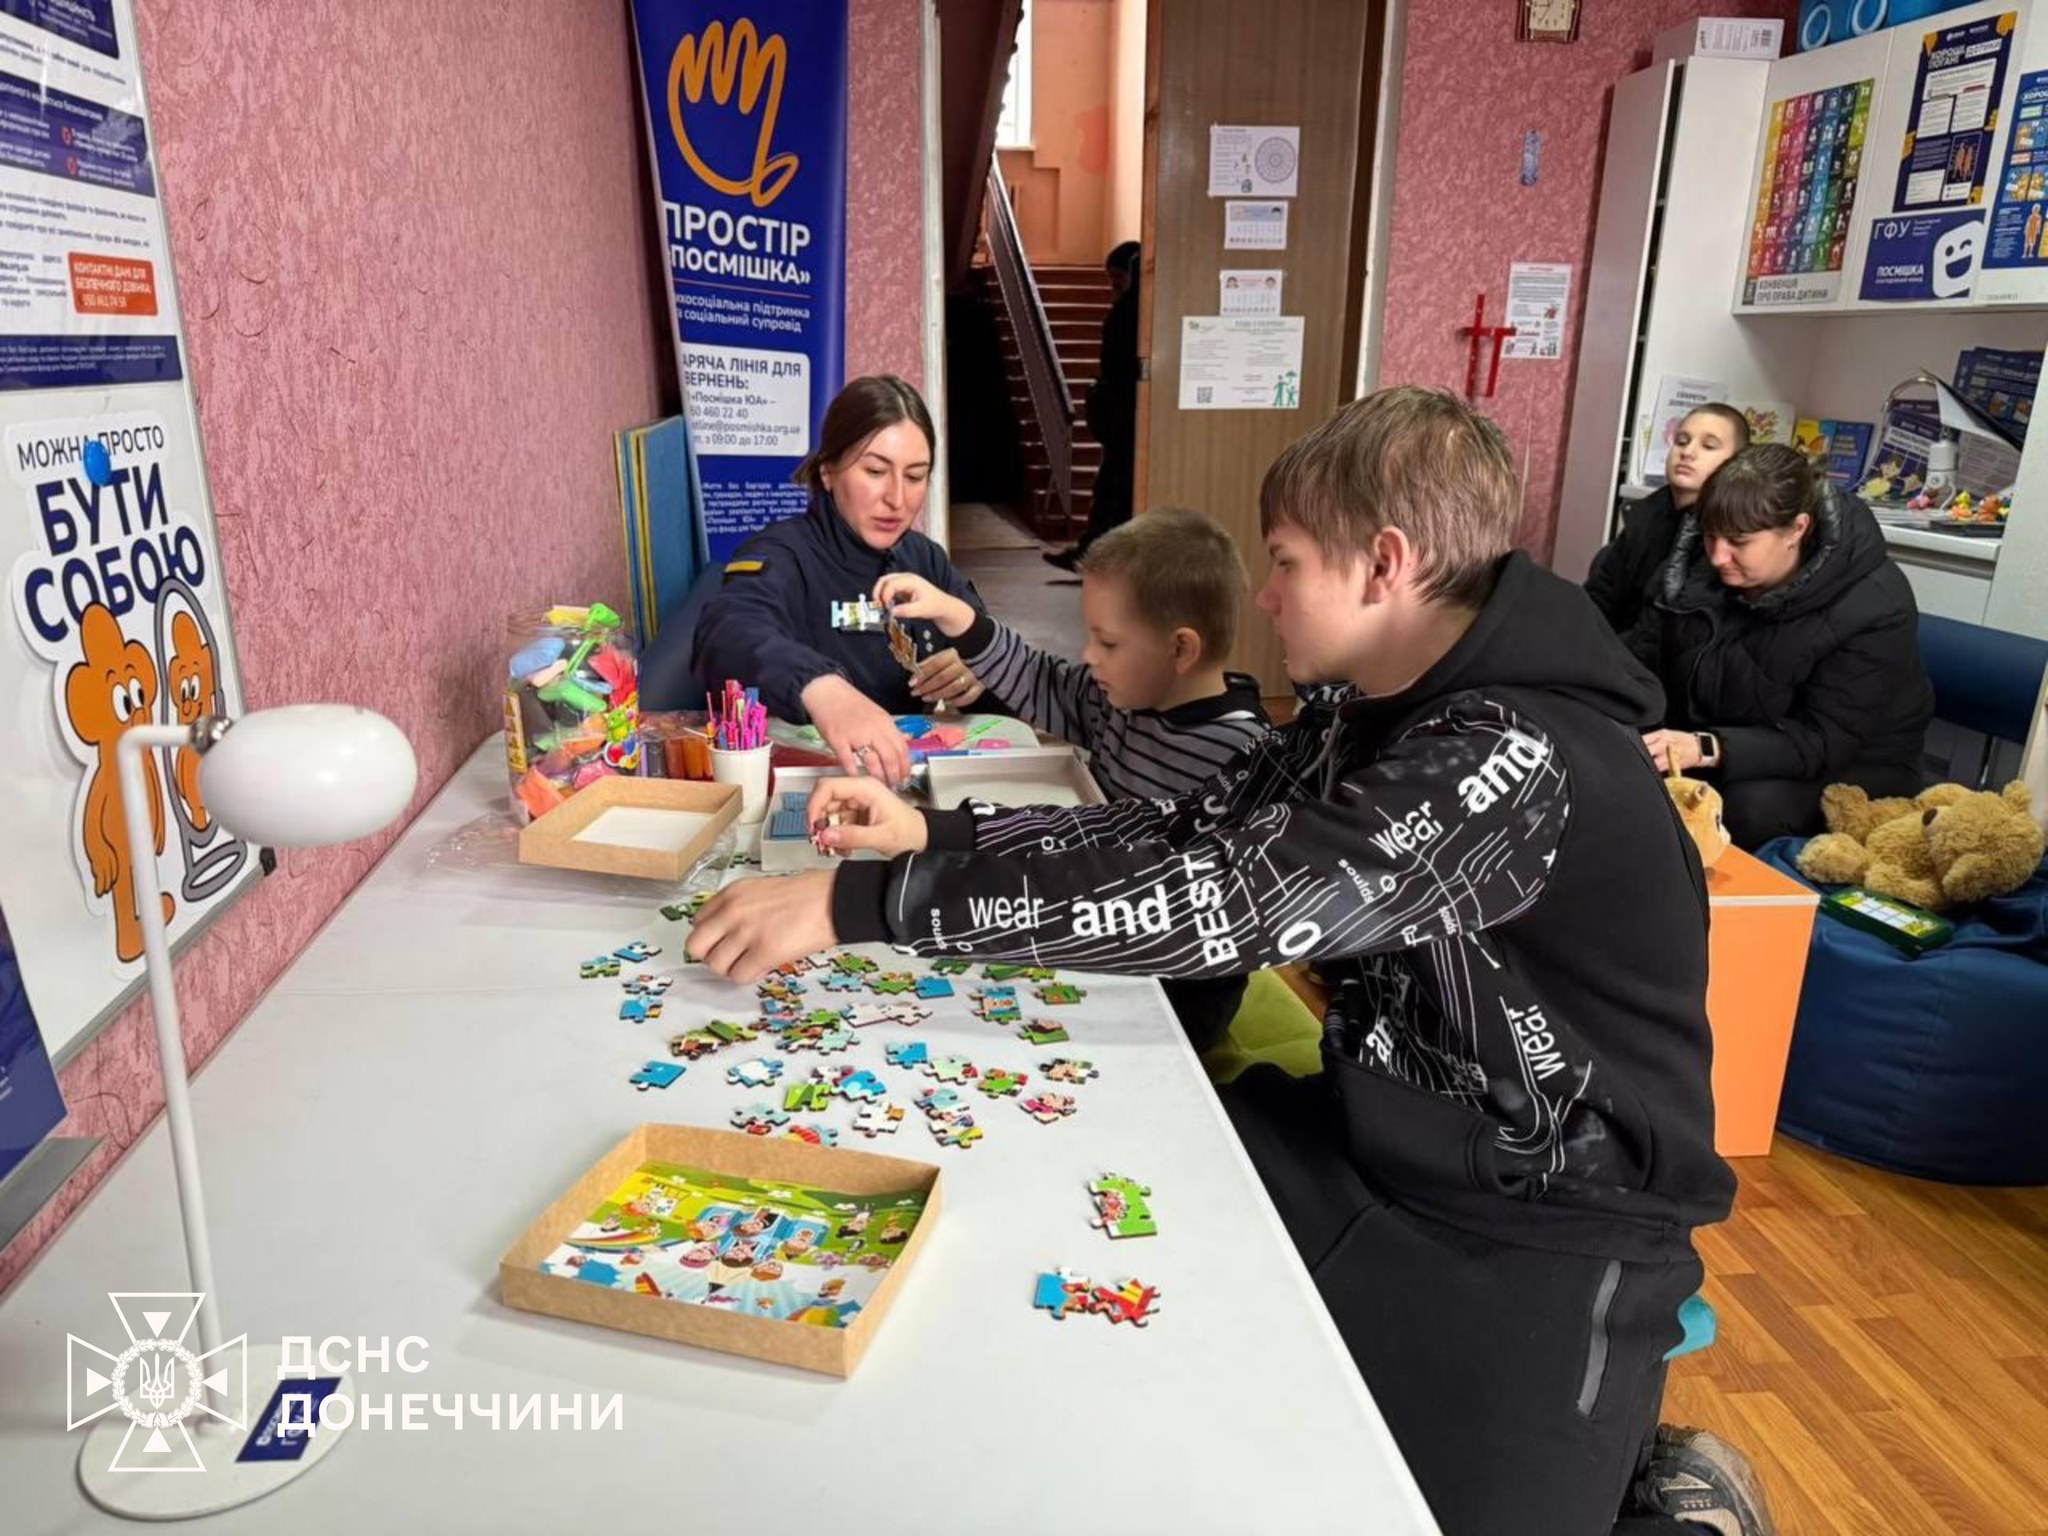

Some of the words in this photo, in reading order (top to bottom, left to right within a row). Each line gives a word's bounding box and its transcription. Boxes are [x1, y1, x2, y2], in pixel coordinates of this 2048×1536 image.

[663, 200, 811, 257] ПРОСТІР
[1874, 219, 1911, 240] ГФУ
[669, 244, 811, 285] ПОСМІШКА»
[684, 308, 750, 327] соціальний
[751, 317, 802, 333] супровід
[752, 300, 811, 319] підтримка
[729, 357, 769, 374] ЛІНІЯ
[772, 361, 802, 377] ДЛЯ
[17, 434, 90, 470] МОЖН
[754, 435, 778, 446] 17:00
[36, 462, 169, 557] БУТИ
[25, 526, 205, 643] СОБОЮ
[1458, 728, 1549, 813] and
[968, 897, 1044, 929] wear
[1072, 884, 1172, 937] and
[1183, 854, 1240, 967] BEST
